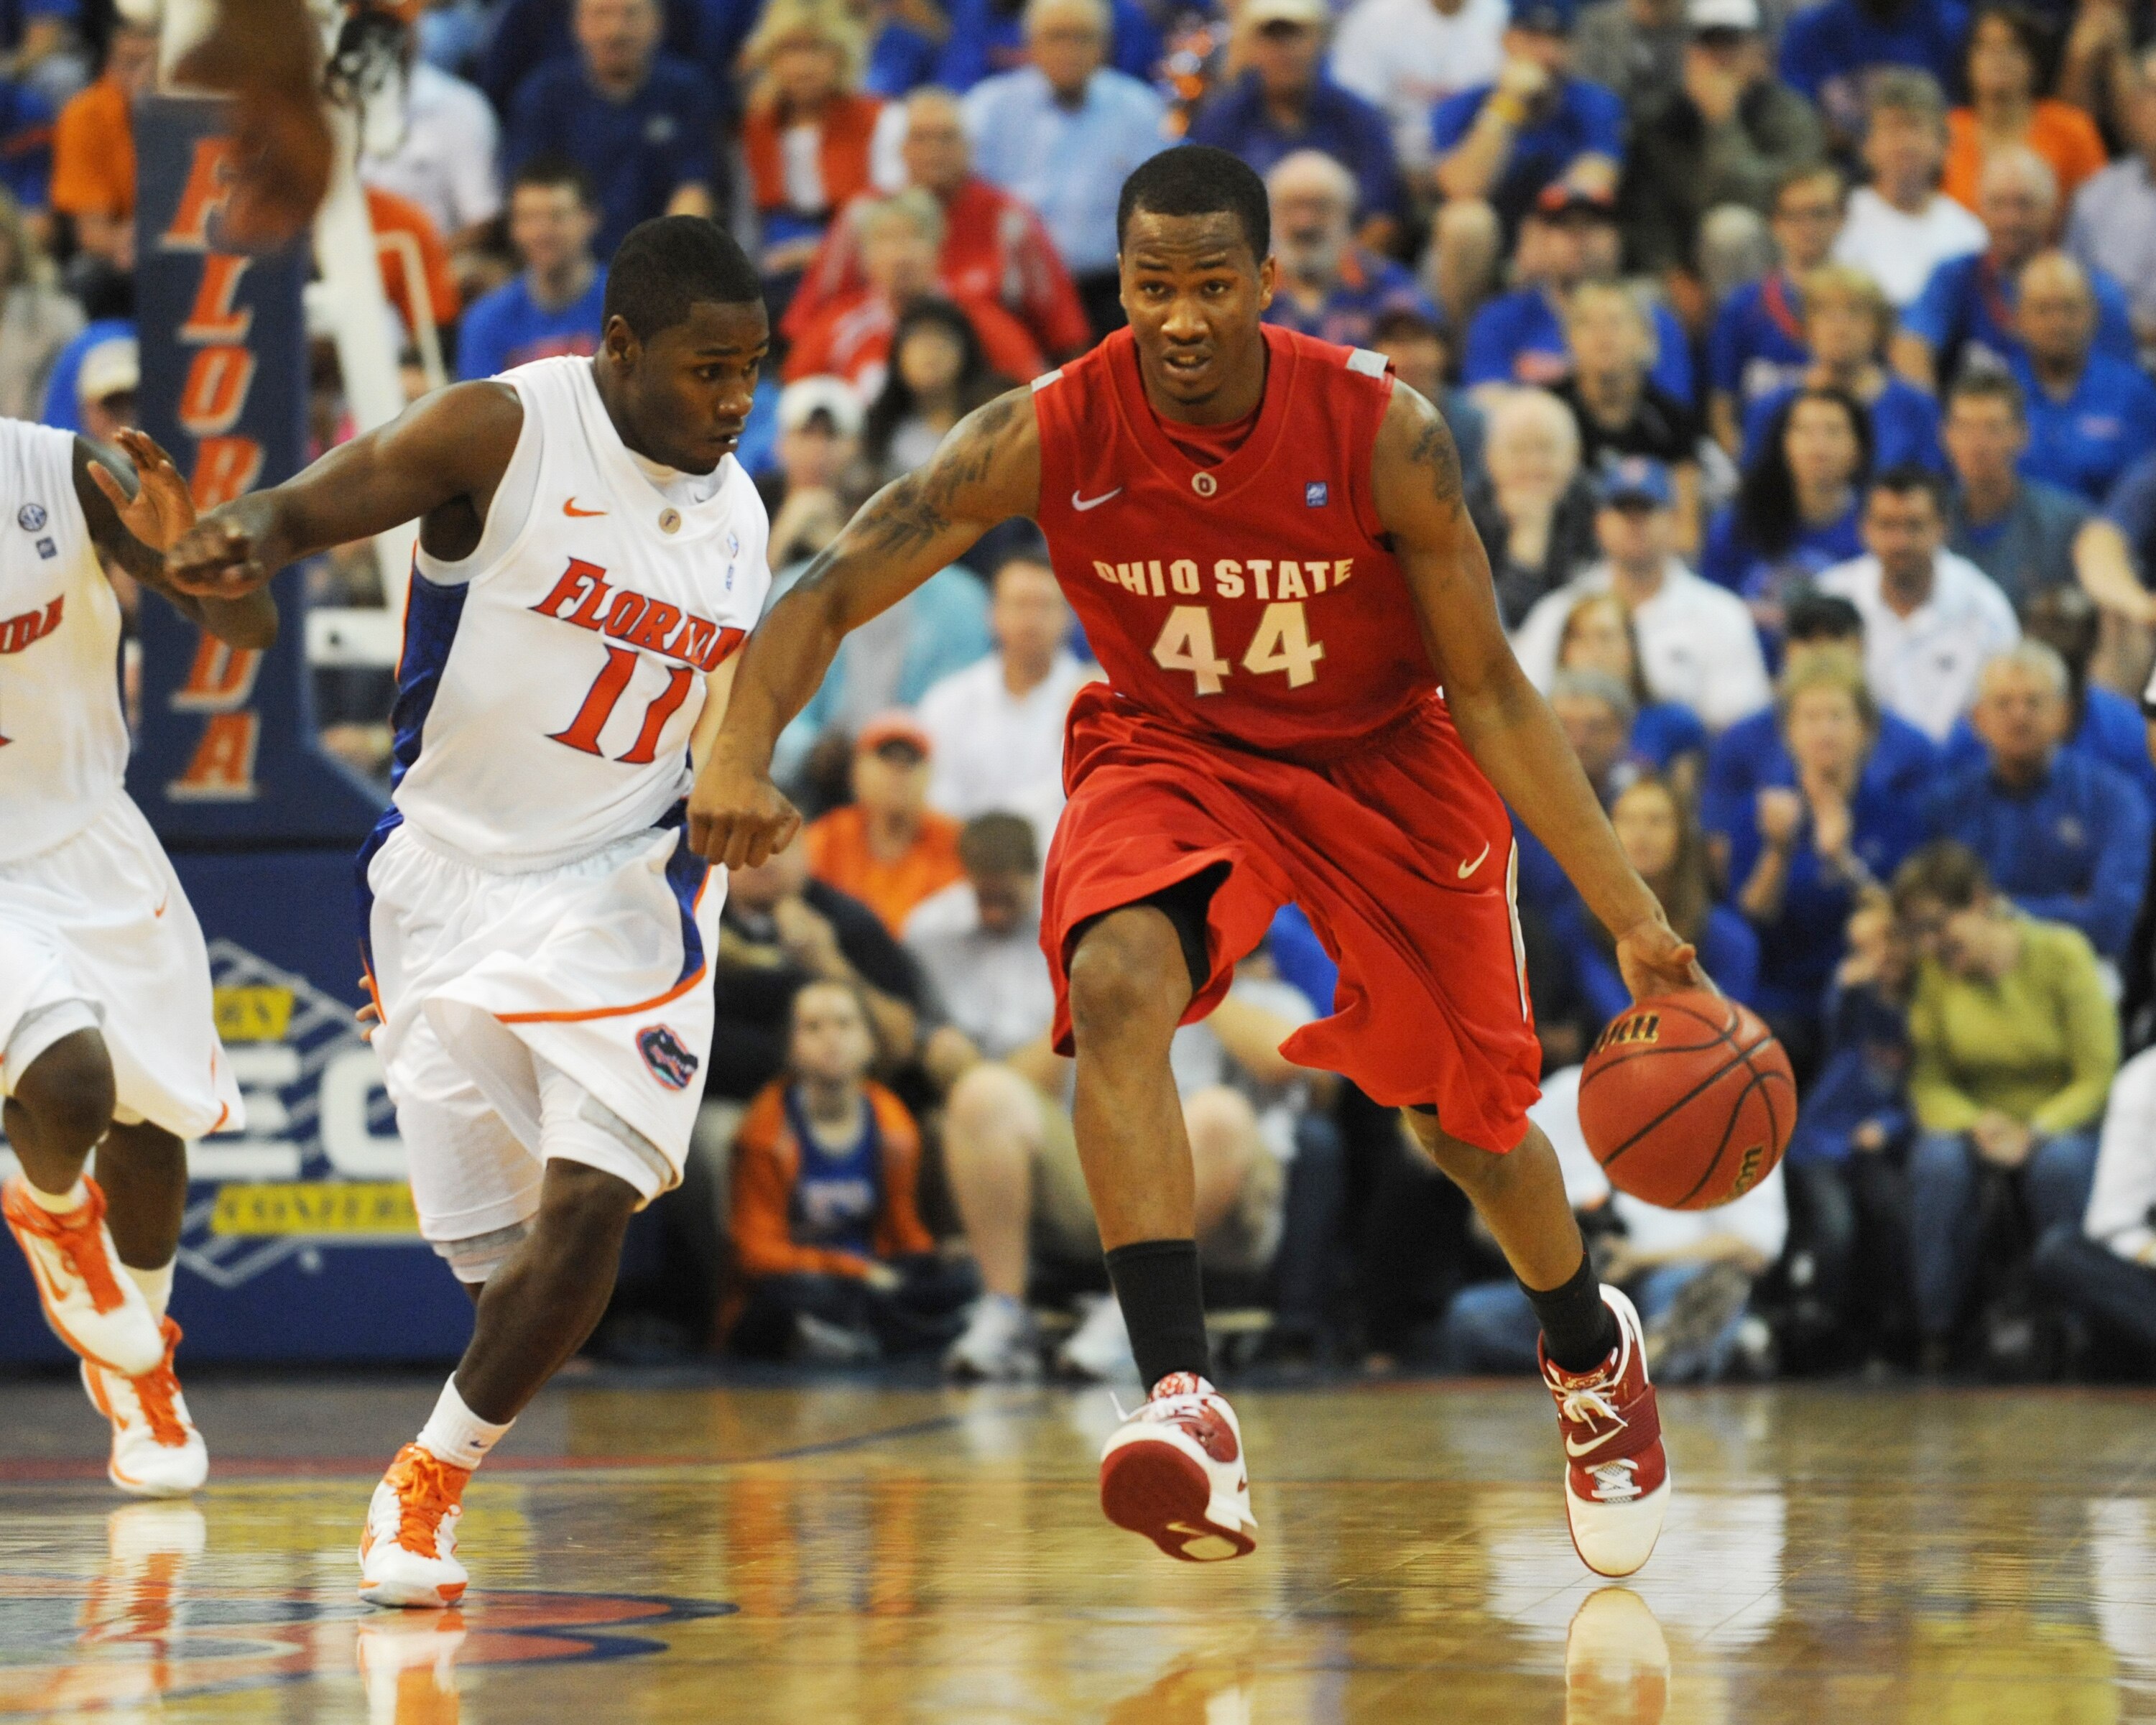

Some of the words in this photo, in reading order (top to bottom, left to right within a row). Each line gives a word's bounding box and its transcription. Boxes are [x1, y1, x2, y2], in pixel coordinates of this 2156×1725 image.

[1092, 559, 1200, 597] OHIO
[1214, 558, 1354, 599] STATE
[1151, 601, 1325, 697] 44
[544, 643, 693, 764] 11
